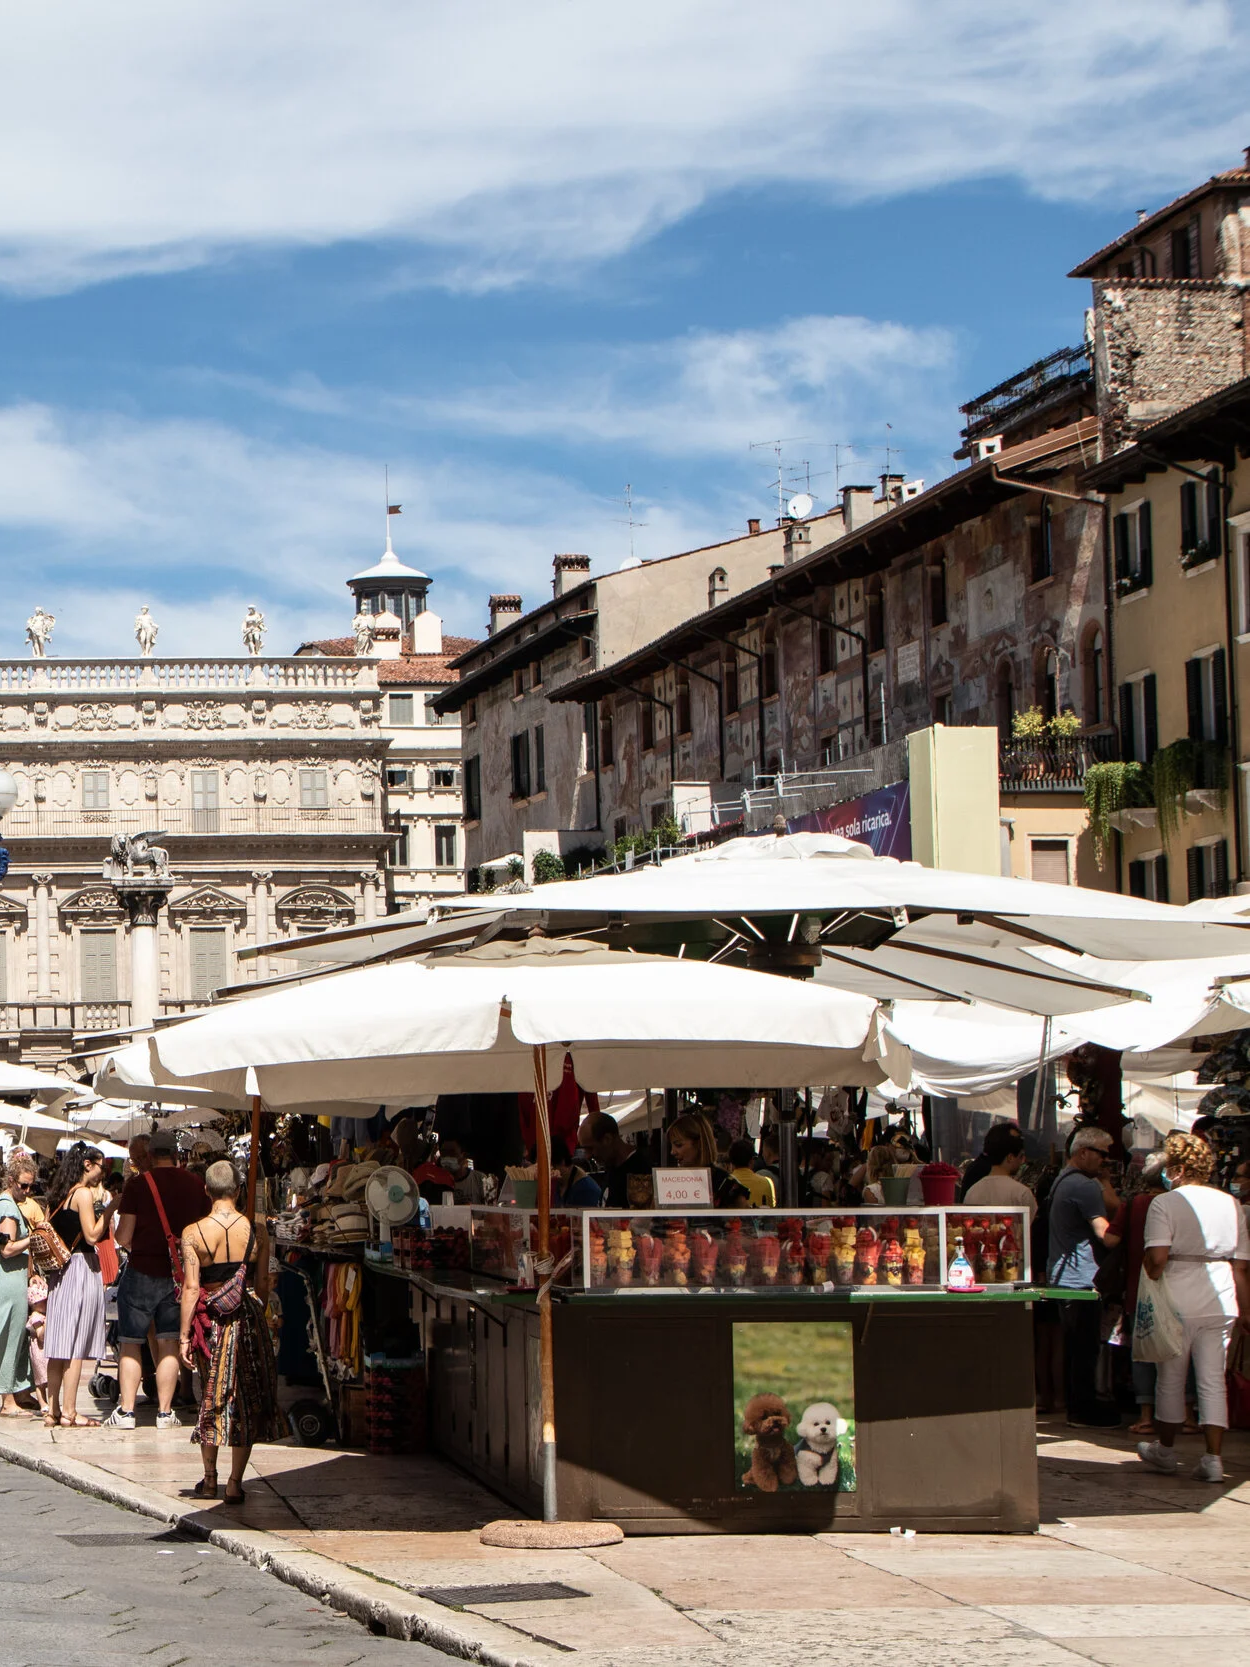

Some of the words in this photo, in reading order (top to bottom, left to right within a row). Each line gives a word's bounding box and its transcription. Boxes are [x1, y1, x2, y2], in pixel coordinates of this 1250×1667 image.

[845, 817, 861, 838] sola
[861, 810, 892, 833] ricarica.
[665, 1190, 688, 1200] 4,00
[693, 1190, 701, 1198] €
